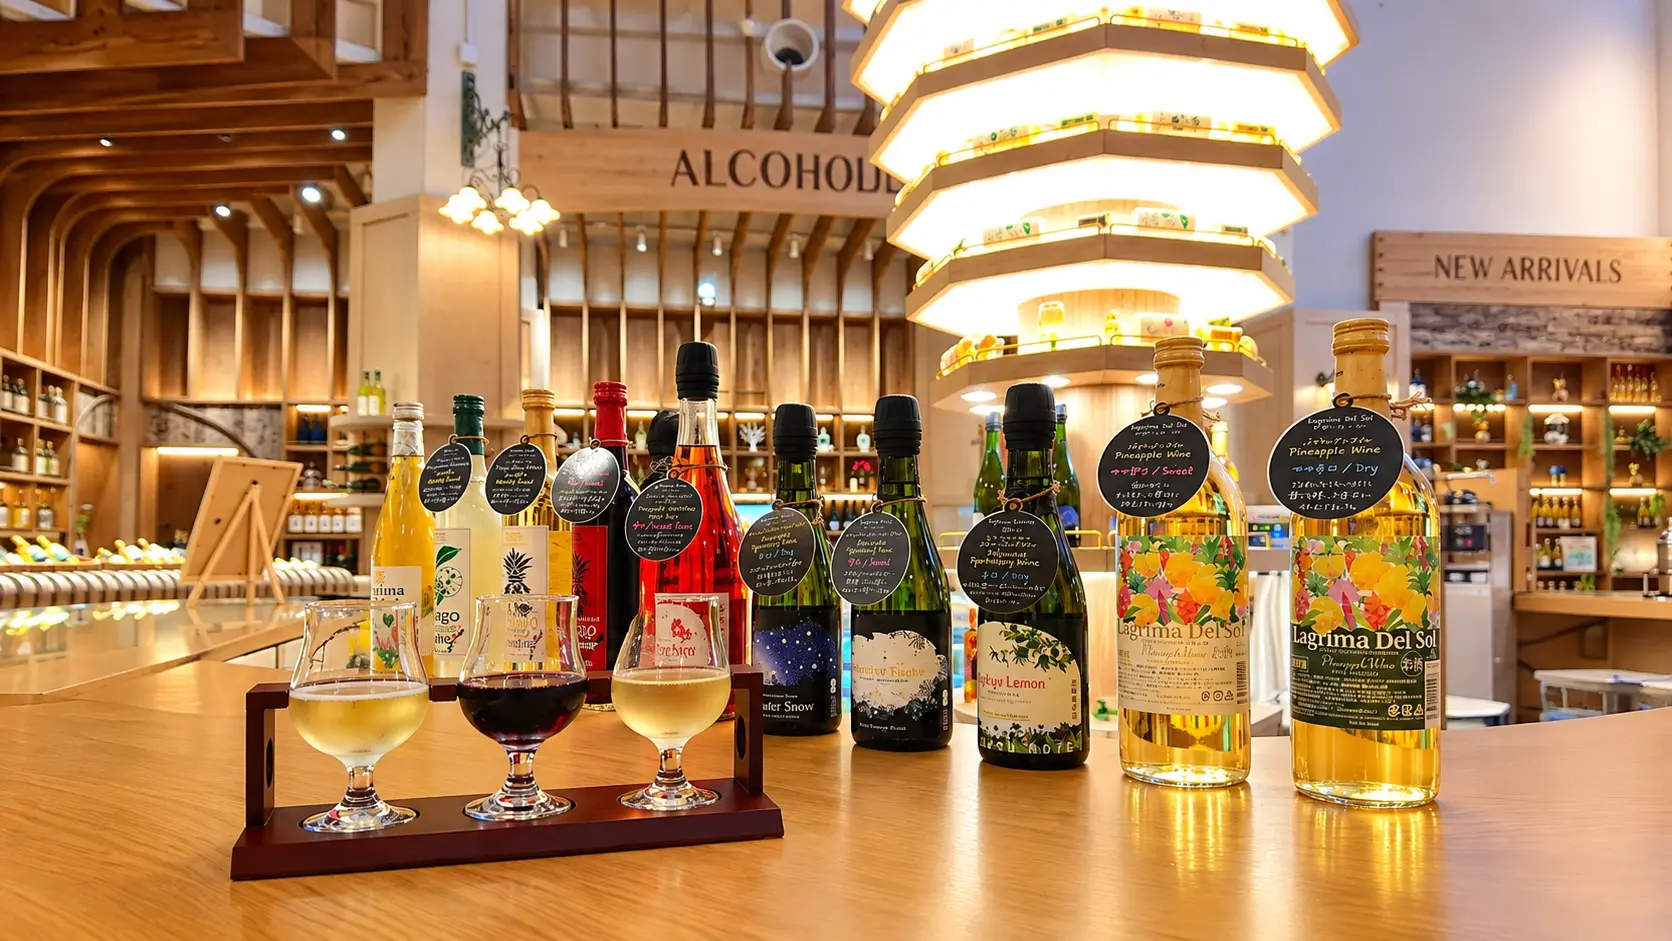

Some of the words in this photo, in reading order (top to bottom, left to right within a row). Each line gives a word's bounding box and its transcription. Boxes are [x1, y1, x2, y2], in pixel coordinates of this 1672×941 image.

[1434, 253, 1493, 280] NEW
[1500, 256, 1622, 284] ARRIVALS
[1114, 451, 1163, 462] Pineapple
[1167, 450, 1192, 458] Wine
[1289, 446, 1345, 460] Pineapple
[1351, 445, 1381, 454] Wine
[1356, 463, 1379, 477] Dry
[1117, 618, 1182, 641] Lagrima
[1190, 623, 1220, 639] Del
[1224, 622, 1245, 639] Sol
[1293, 625, 1369, 651] Lagrima
[1375, 630, 1415, 649] Del
[1416, 630, 1437, 649] Sol
[1006, 675, 1046, 690] Lemon
[784, 700, 815, 712] Snow
